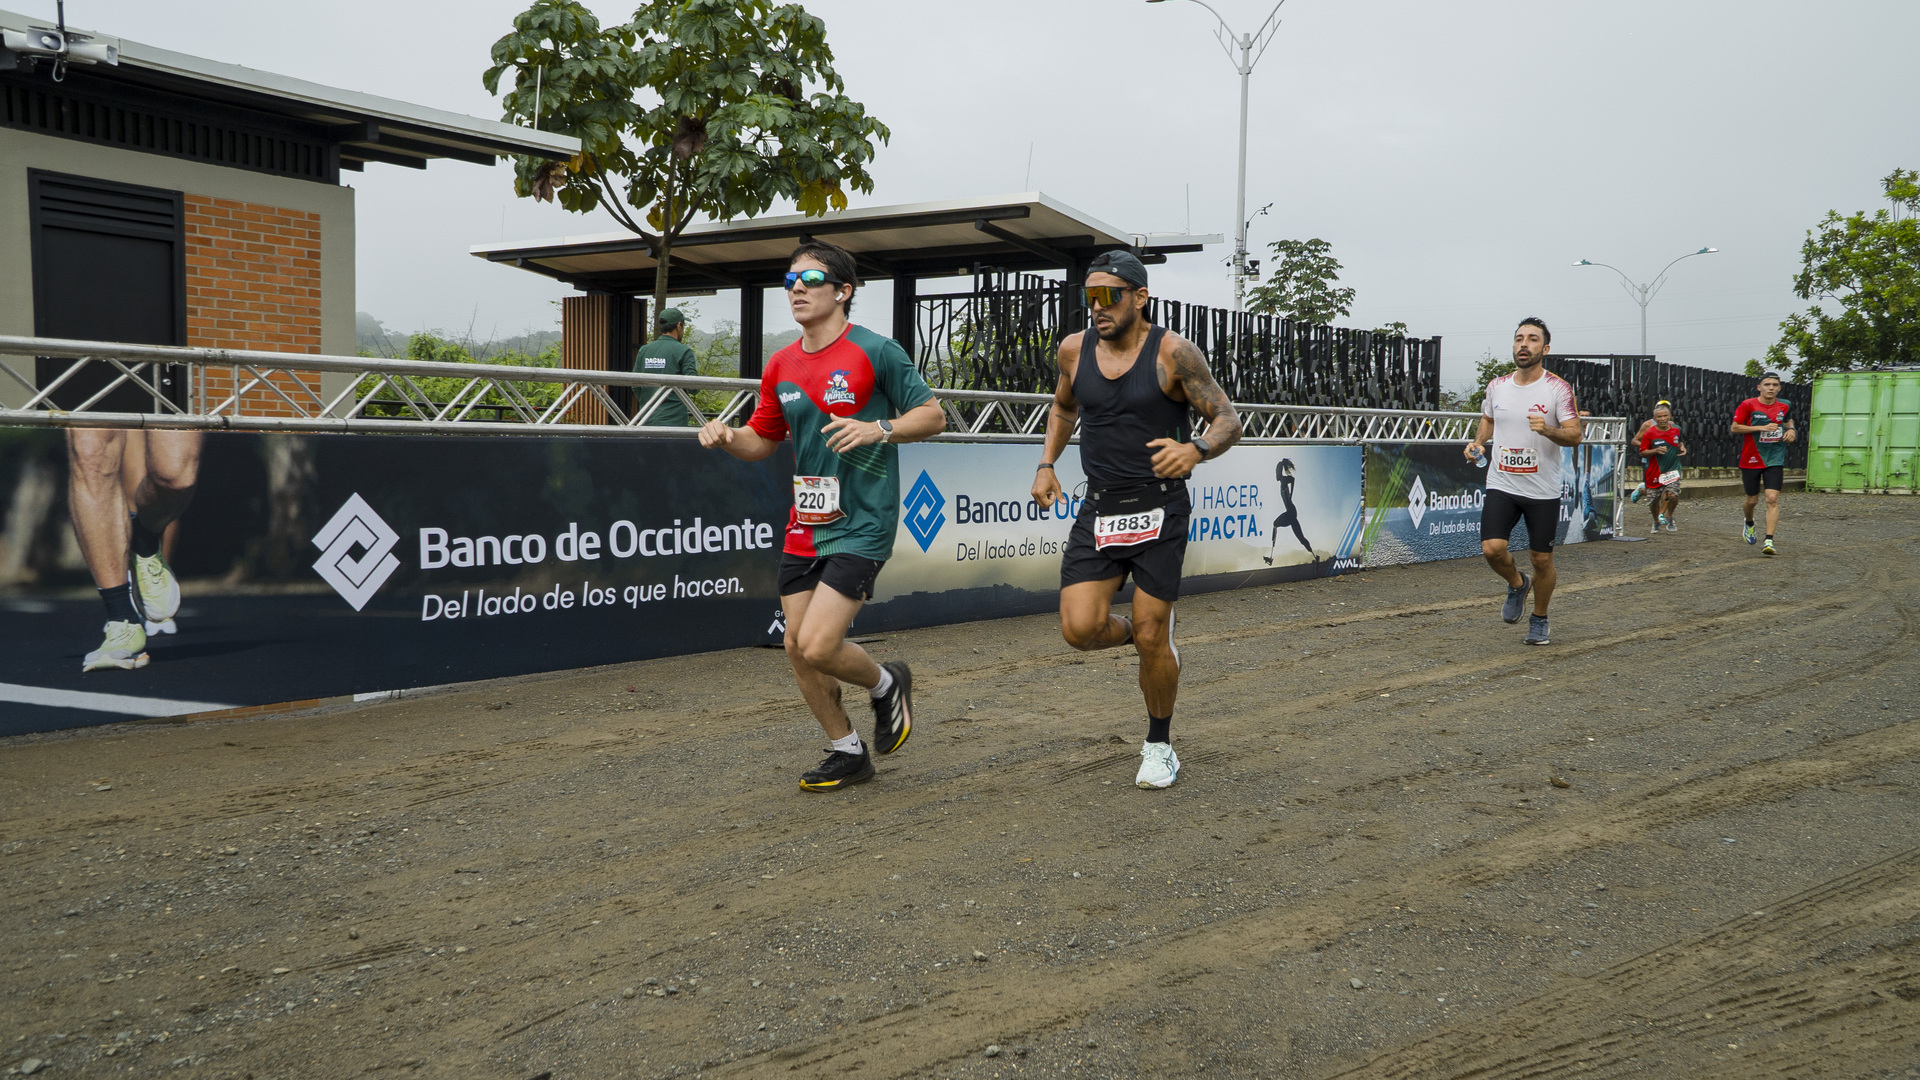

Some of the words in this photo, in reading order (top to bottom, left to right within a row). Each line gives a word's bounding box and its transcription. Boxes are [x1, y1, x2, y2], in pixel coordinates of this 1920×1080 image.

[1503, 455, 1531, 466] 1804
[798, 492, 826, 510] 220
[1203, 485, 1263, 510] HACER,
[1430, 490, 1459, 511] Banco
[1460, 489, 1473, 509] de
[1560, 484, 1572, 502] ER,
[956, 494, 1022, 525] Banco
[1026, 500, 1050, 521] de
[1559, 504, 1572, 522] TA.
[1107, 514, 1151, 533] 1883
[1188, 514, 1263, 542] MPACTA.
[1429, 521, 1441, 536] Del
[1441, 520, 1457, 534] lado
[1457, 519, 1466, 533] de
[1466, 518, 1476, 532] los
[419, 527, 547, 570] Banco
[555, 522, 601, 562] de
[609, 517, 774, 559] Occidente
[956, 540, 980, 562] Del
[984, 539, 1016, 560] lado
[1019, 537, 1036, 557] de
[1039, 536, 1058, 555] los
[1333, 558, 1359, 570] AVAL
[421, 590, 469, 622] Del
[476, 586, 537, 617] lado
[542, 583, 575, 611] de
[582, 581, 617, 608] los
[623, 578, 667, 610] que
[673, 574, 746, 600] hacen.
